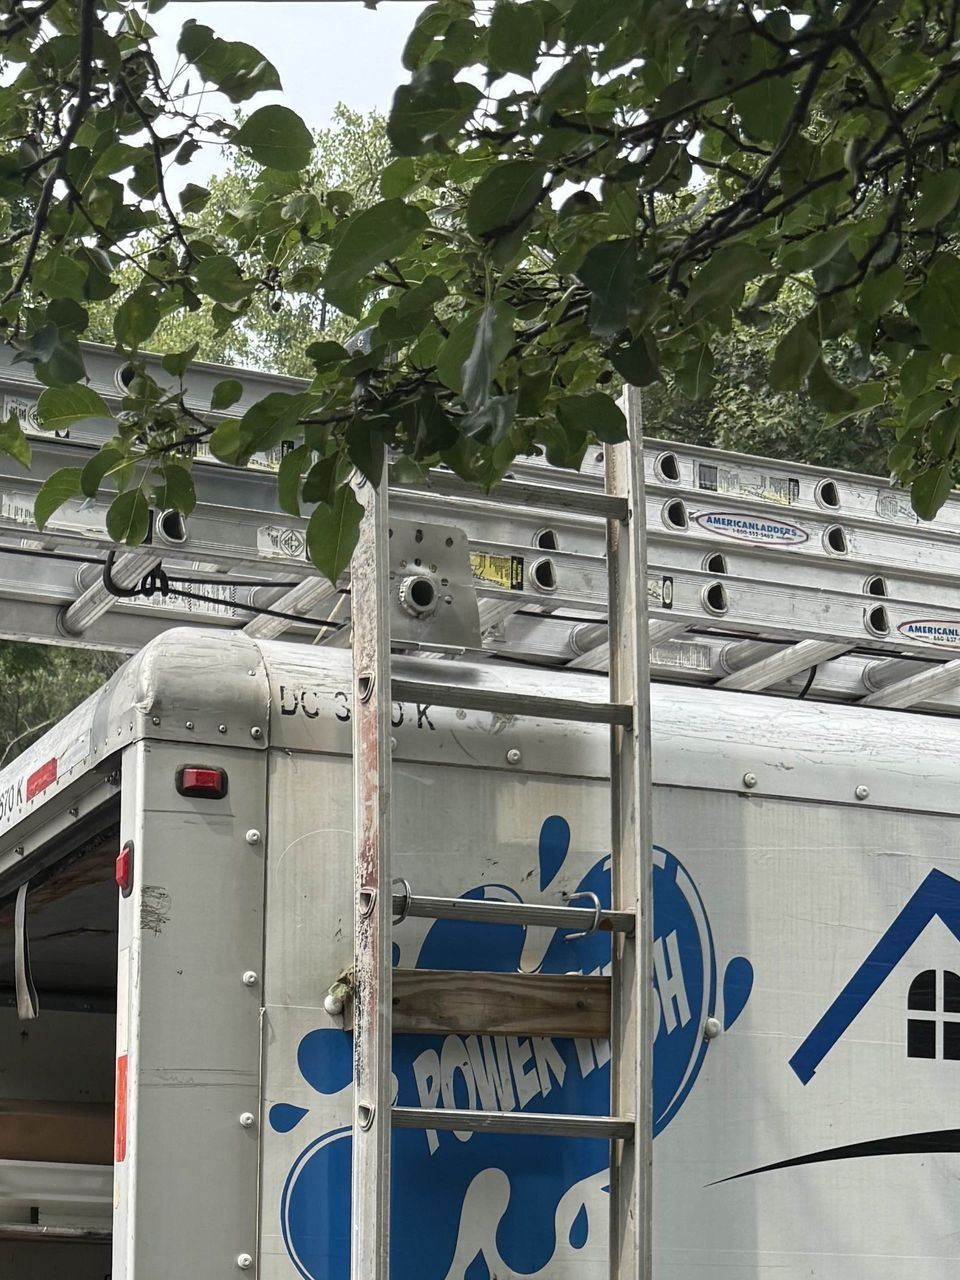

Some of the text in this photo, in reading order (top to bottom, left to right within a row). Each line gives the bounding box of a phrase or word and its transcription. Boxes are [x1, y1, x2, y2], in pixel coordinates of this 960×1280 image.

[706, 516, 797, 537] AMERICANLADDERS
[280, 685, 436, 731] DC 30 K
[16, 776, 24, 807] K
